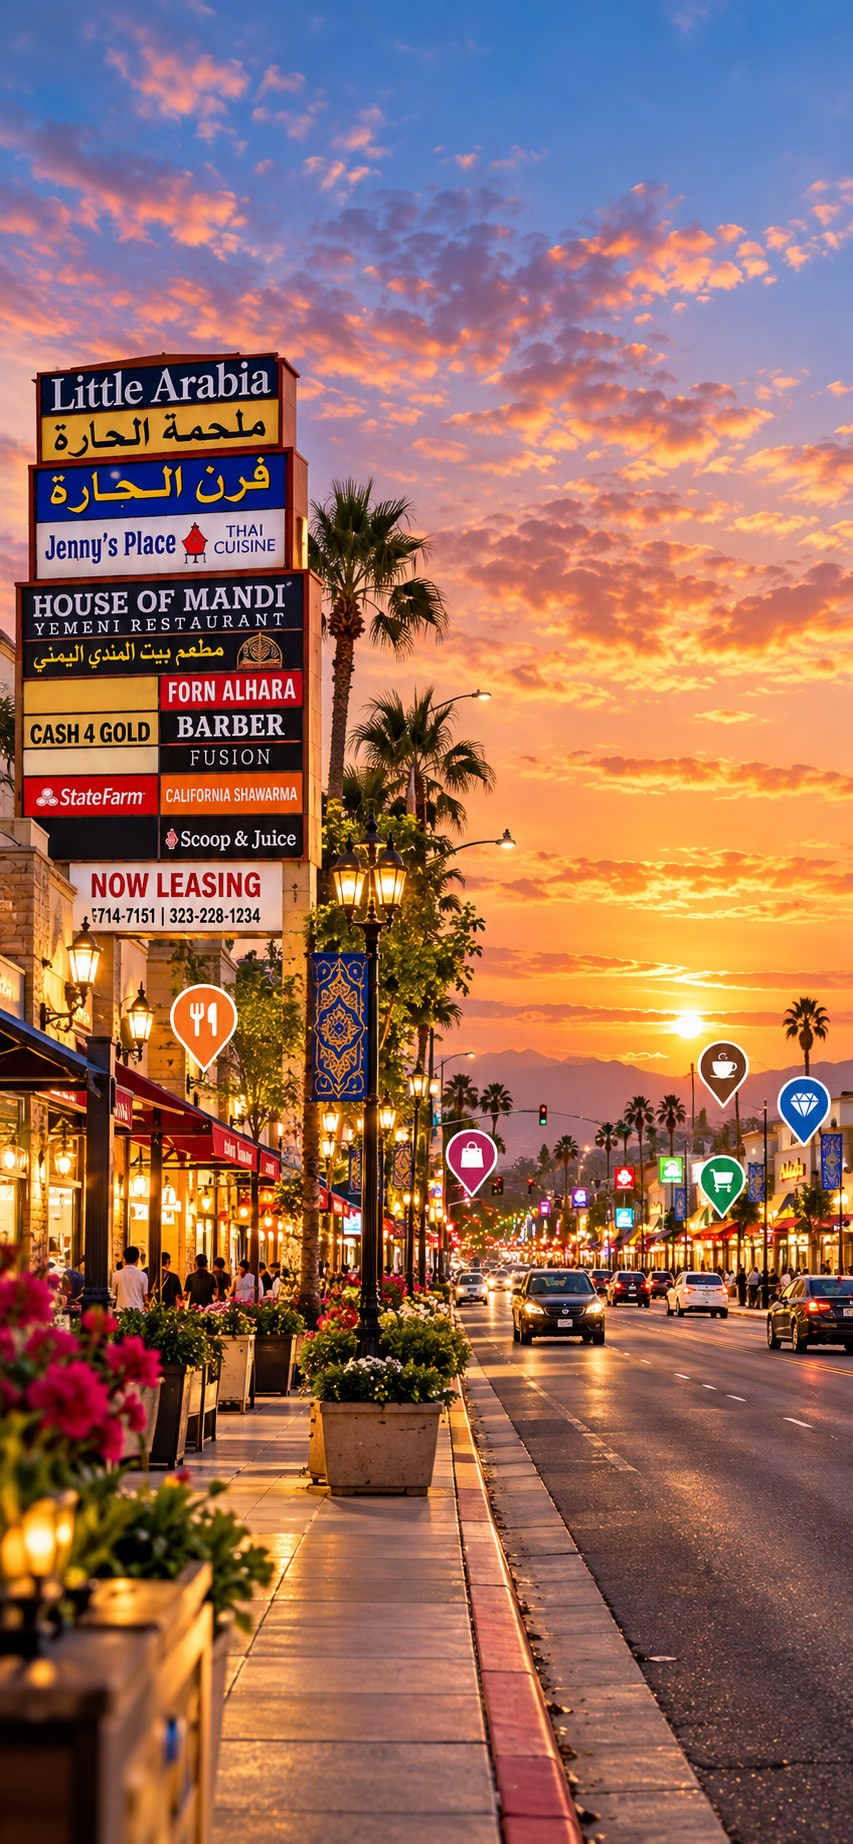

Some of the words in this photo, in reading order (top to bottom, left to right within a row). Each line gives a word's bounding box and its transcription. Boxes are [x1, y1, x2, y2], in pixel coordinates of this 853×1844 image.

[51, 371, 143, 411] Little
[151, 361, 271, 403] Arabia
[54, 417, 150, 457] الحارة
[162, 409, 266, 442] ملحمة
[195, 457, 270, 504] فرن
[226, 524, 263, 538] THAI
[45, 533, 117, 564] Jenny's
[124, 531, 176, 556] Place
[214, 539, 275, 554] CUISINE
[33, 593, 128, 617] HOUSE
[138, 590, 174, 612] OF
[183, 584, 285, 611] MANDI
[35, 620, 119, 635] YEMENI
[131, 613, 284, 631] RESTAURANT
[88, 642, 135, 666] المندي
[140, 642, 170, 665] بيت
[176, 639, 224, 666] مطعم
[168, 681, 216, 703] FORN
[222, 678, 296, 700] ALHARA
[30, 724, 80, 744] CASH
[84, 724, 95, 743] 4
[99, 722, 151, 742] GOLD
[177, 714, 284, 738] BARBER
[191, 749, 270, 766] FUSION
[166, 788, 230, 802] CALIFORNIA
[234, 787, 297, 801] SHAWARMA
[181, 830, 229, 851] Scoop
[235, 831, 248, 847] &
[252, 830, 296, 848] Juice
[91, 873, 148, 898] NOW
[157, 872, 260, 898] LEASING
[170, 908, 260, 923] 323-228-1234
